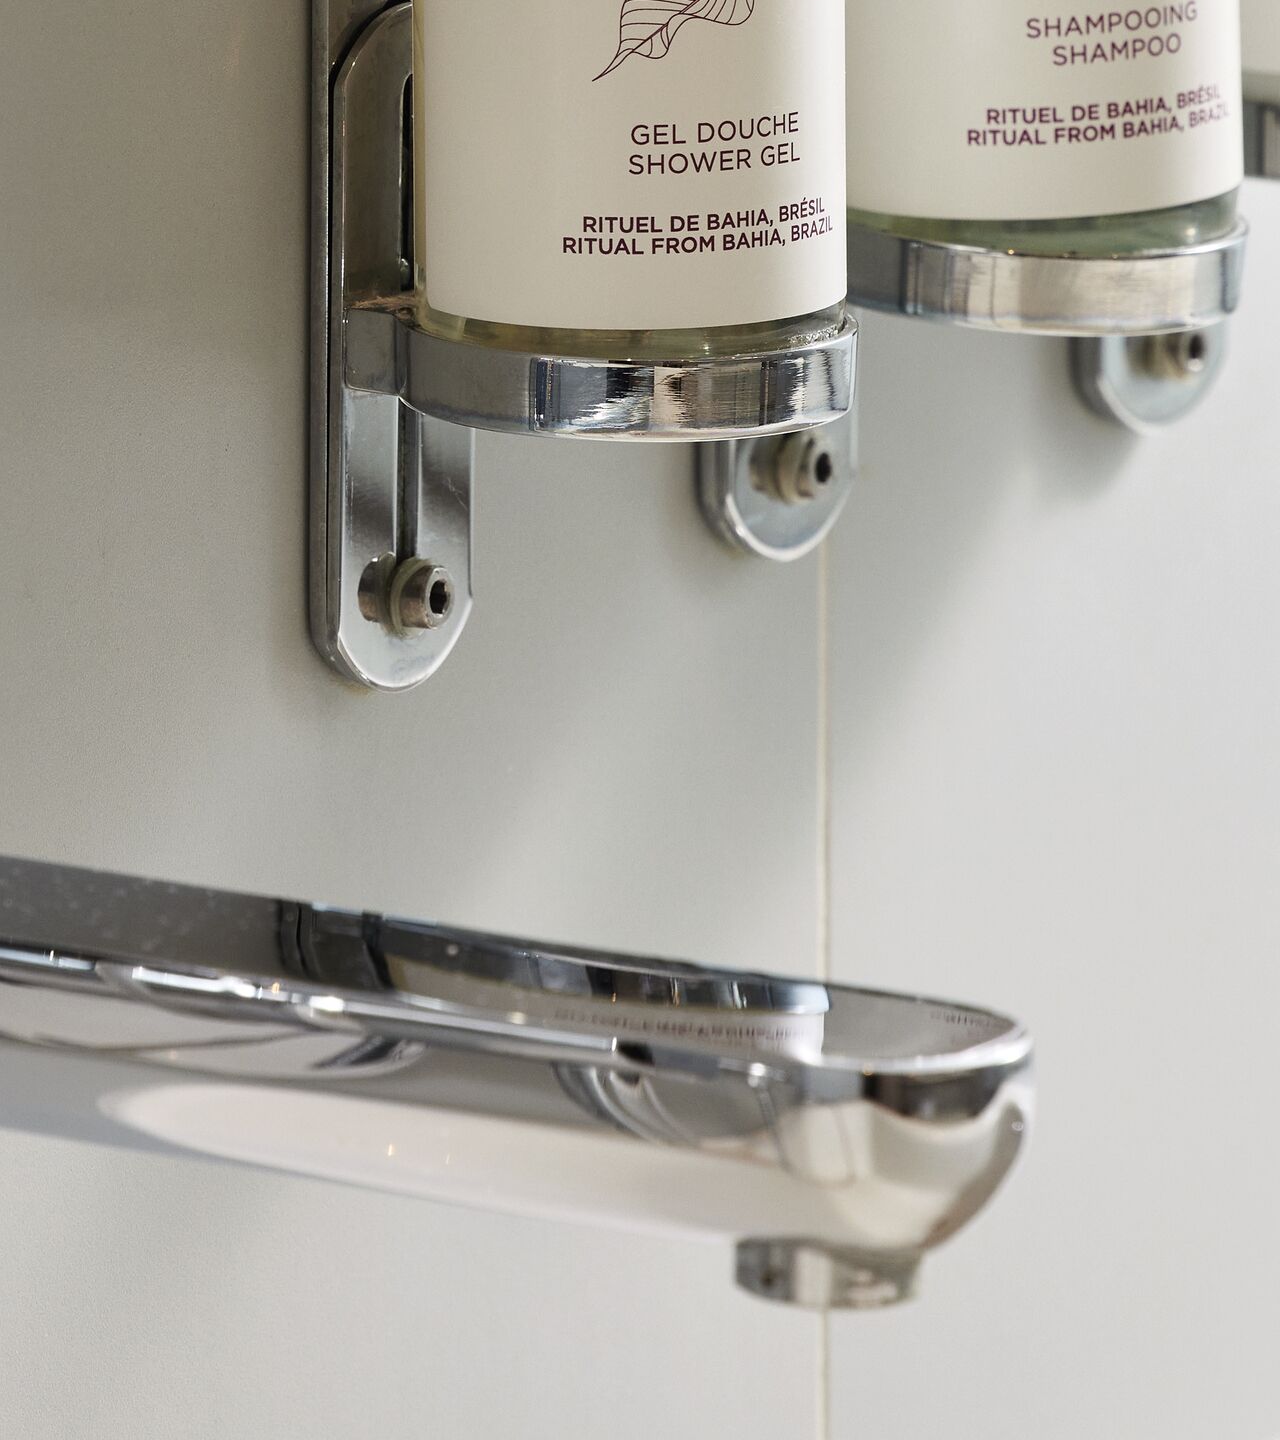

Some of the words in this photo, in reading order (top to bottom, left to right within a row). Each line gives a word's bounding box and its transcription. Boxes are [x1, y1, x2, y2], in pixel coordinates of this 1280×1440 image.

[1026, 0, 1198, 39] SHAMPOOING
[1052, 32, 1182, 66] SHAMPOO
[986, 107, 1064, 125] RITUEL
[1071, 104, 1100, 122] DE
[1107, 97, 1172, 119] BAHIA,
[630, 123, 687, 146] GEL
[697, 111, 799, 144] DOUCHE
[967, 129, 1046, 146] RITUAL
[1054, 124, 1116, 144] FROM
[1123, 116, 1185, 139] BAHIA,
[628, 147, 752, 175] SHOWER
[760, 142, 801, 167] GEL
[583, 216, 663, 234] RITUEL
[670, 214, 700, 232] DE
[707, 208, 774, 231] BAHIA,
[779, 196, 825, 223] BRÉSIL
[562, 236, 644, 255] RITUAL
[651, 235, 716, 254] FROM
[723, 228, 786, 251] BAHIA,
[791, 215, 833, 242] BRAZIL
